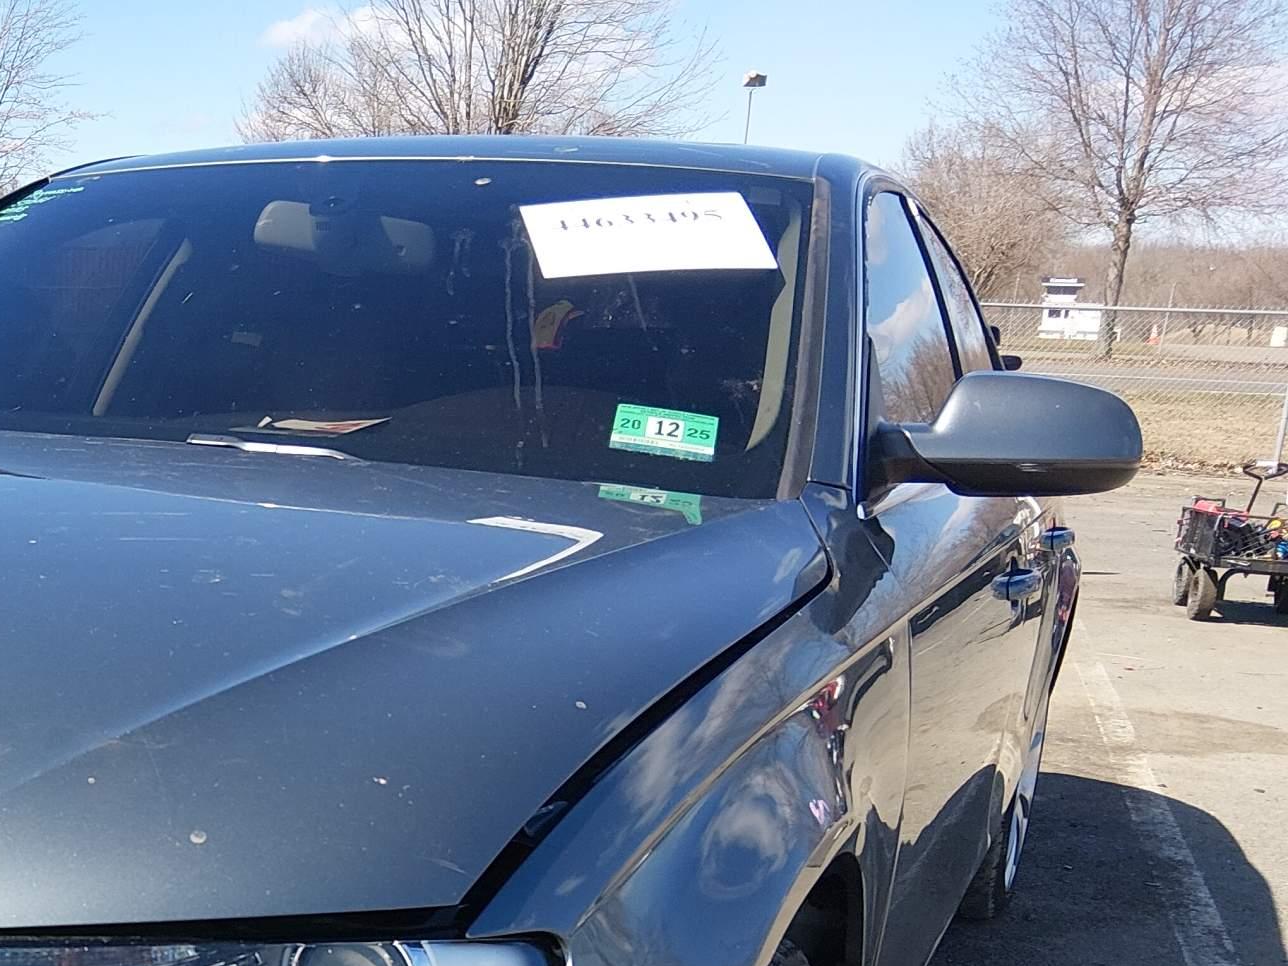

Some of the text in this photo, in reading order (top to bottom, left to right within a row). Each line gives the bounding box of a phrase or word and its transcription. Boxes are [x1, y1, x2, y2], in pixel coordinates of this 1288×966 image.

[620, 418, 711, 440] 20 12 25
